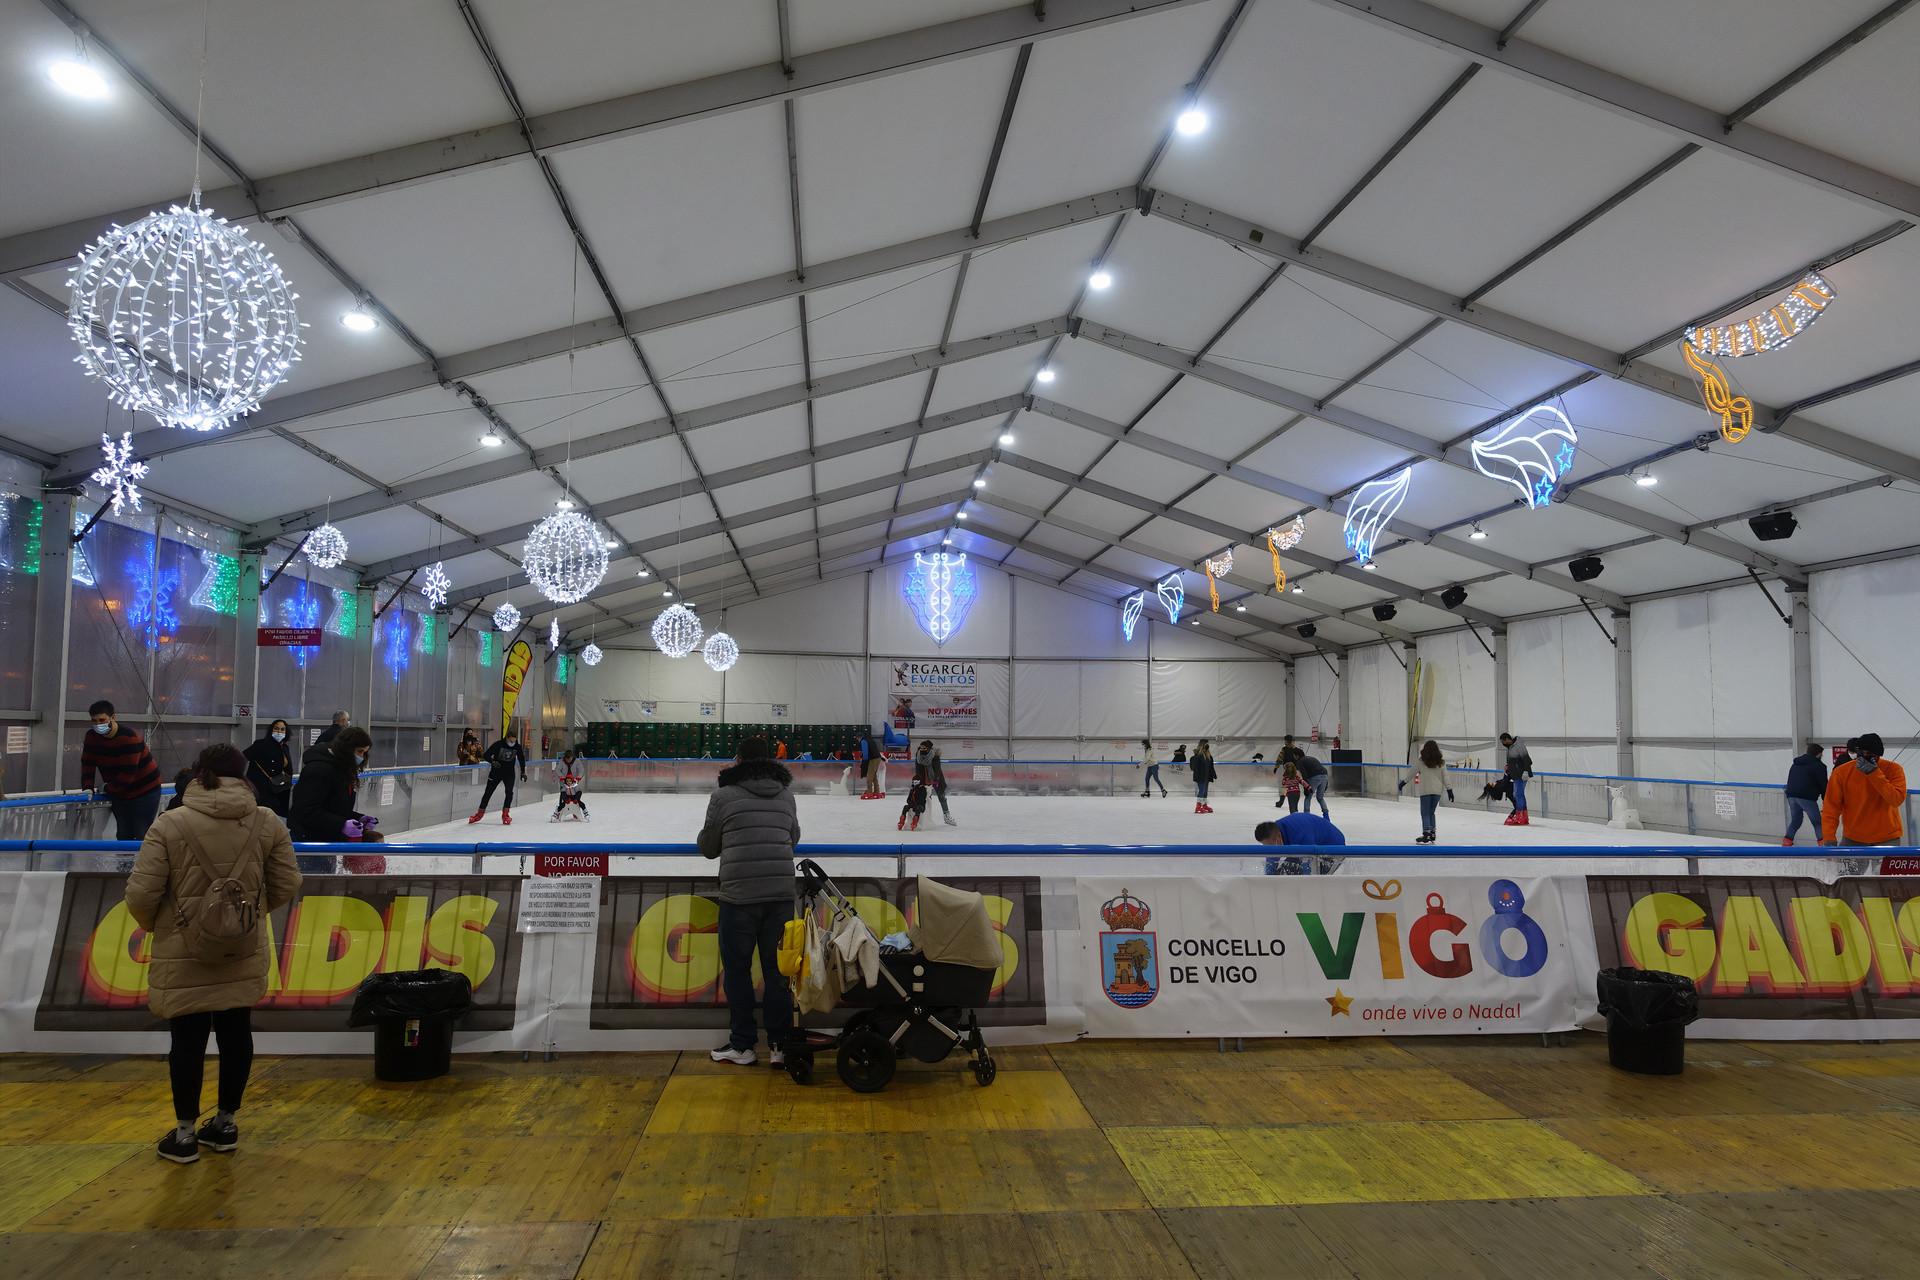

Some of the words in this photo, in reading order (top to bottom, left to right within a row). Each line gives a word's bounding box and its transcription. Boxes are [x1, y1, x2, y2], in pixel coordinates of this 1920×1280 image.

[911, 663, 975, 675] RGARCÍA
[911, 675, 975, 684] EVENTOS
[544, 856, 565, 867] POR
[567, 856, 600, 867] FAVOR
[1889, 859, 1907, 869] POR
[1168, 939, 1285, 956] CONCELLO
[1170, 966, 1199, 983] DE
[1205, 966, 1257, 983] VIGO
[1362, 1005, 1406, 1020] onde
[1413, 1005, 1447, 1019] vive
[1453, 1007, 1462, 1019] o
[1469, 1003, 1520, 1019] Nadal
